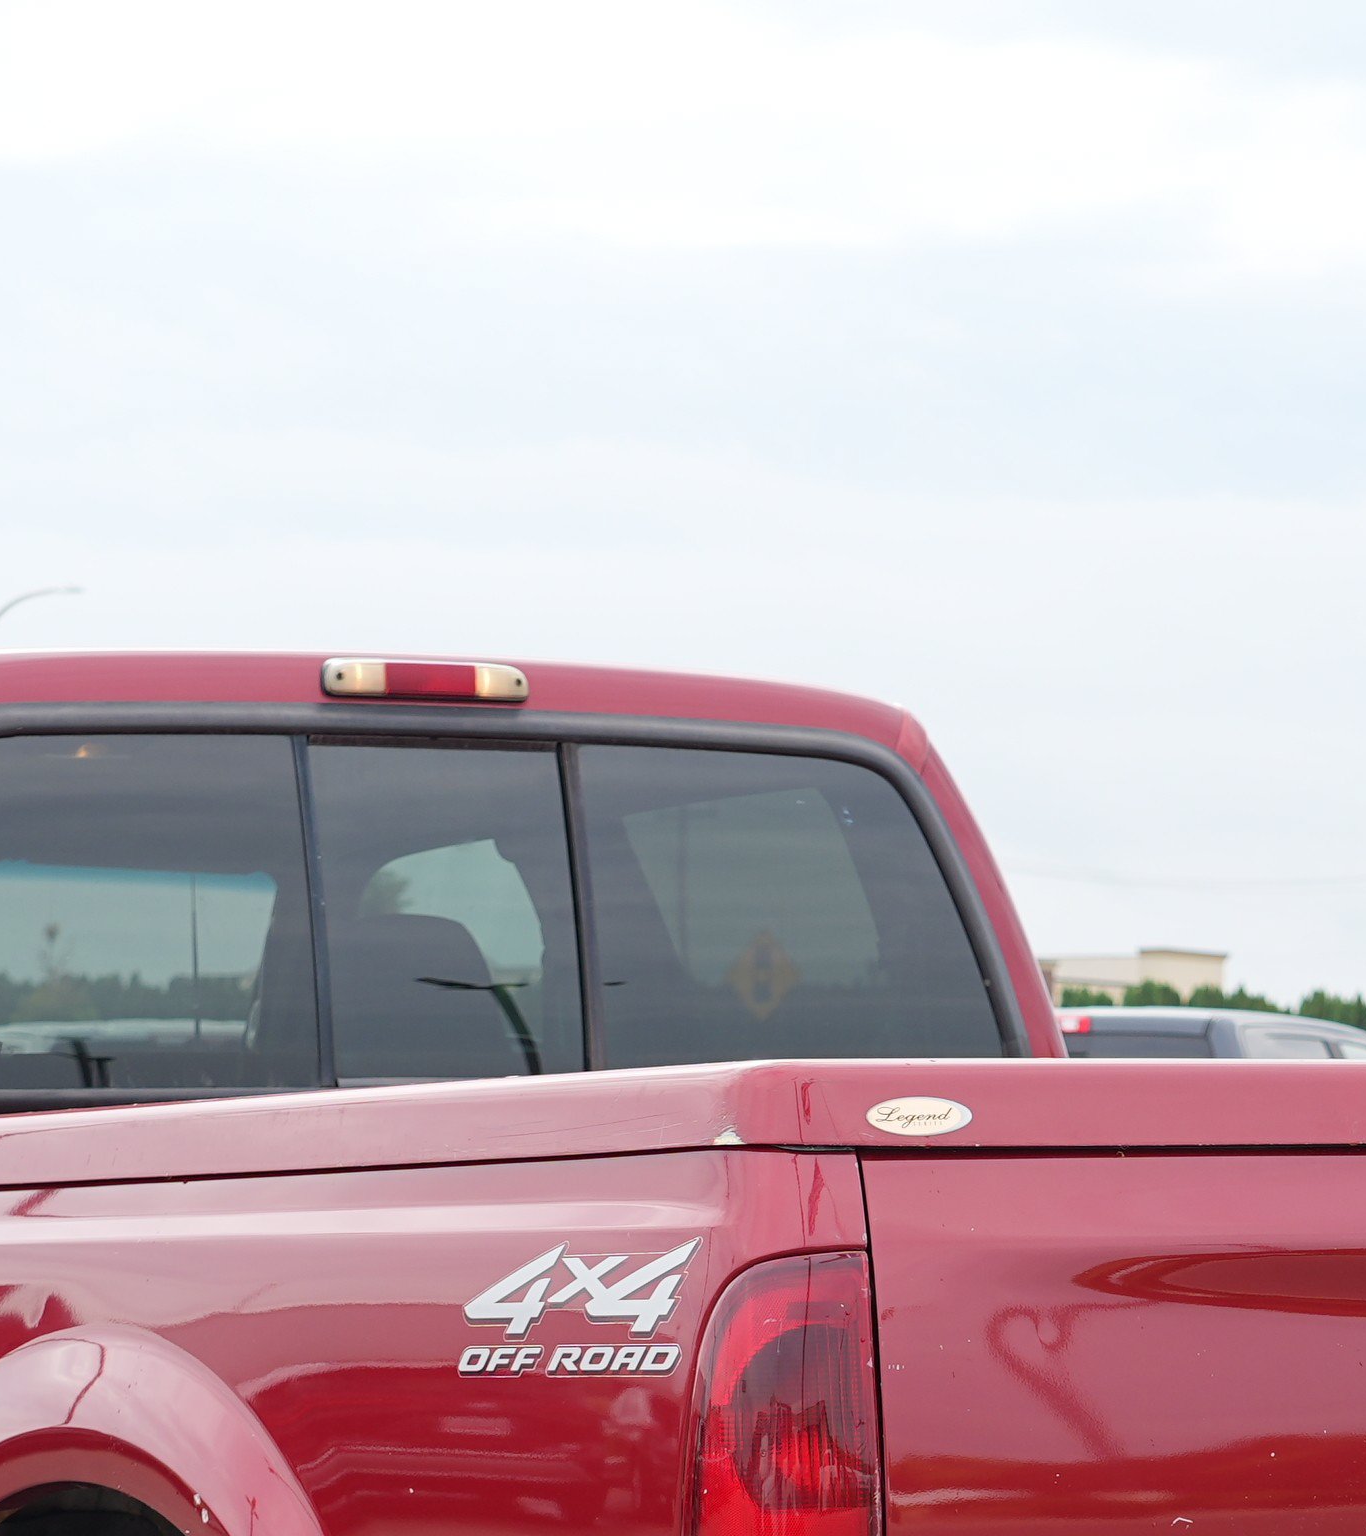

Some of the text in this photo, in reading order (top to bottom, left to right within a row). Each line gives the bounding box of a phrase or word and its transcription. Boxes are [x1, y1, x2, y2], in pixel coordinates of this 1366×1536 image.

[875, 1106, 953, 1128] Legend
[457, 1345, 681, 1375] OFF ROAD
